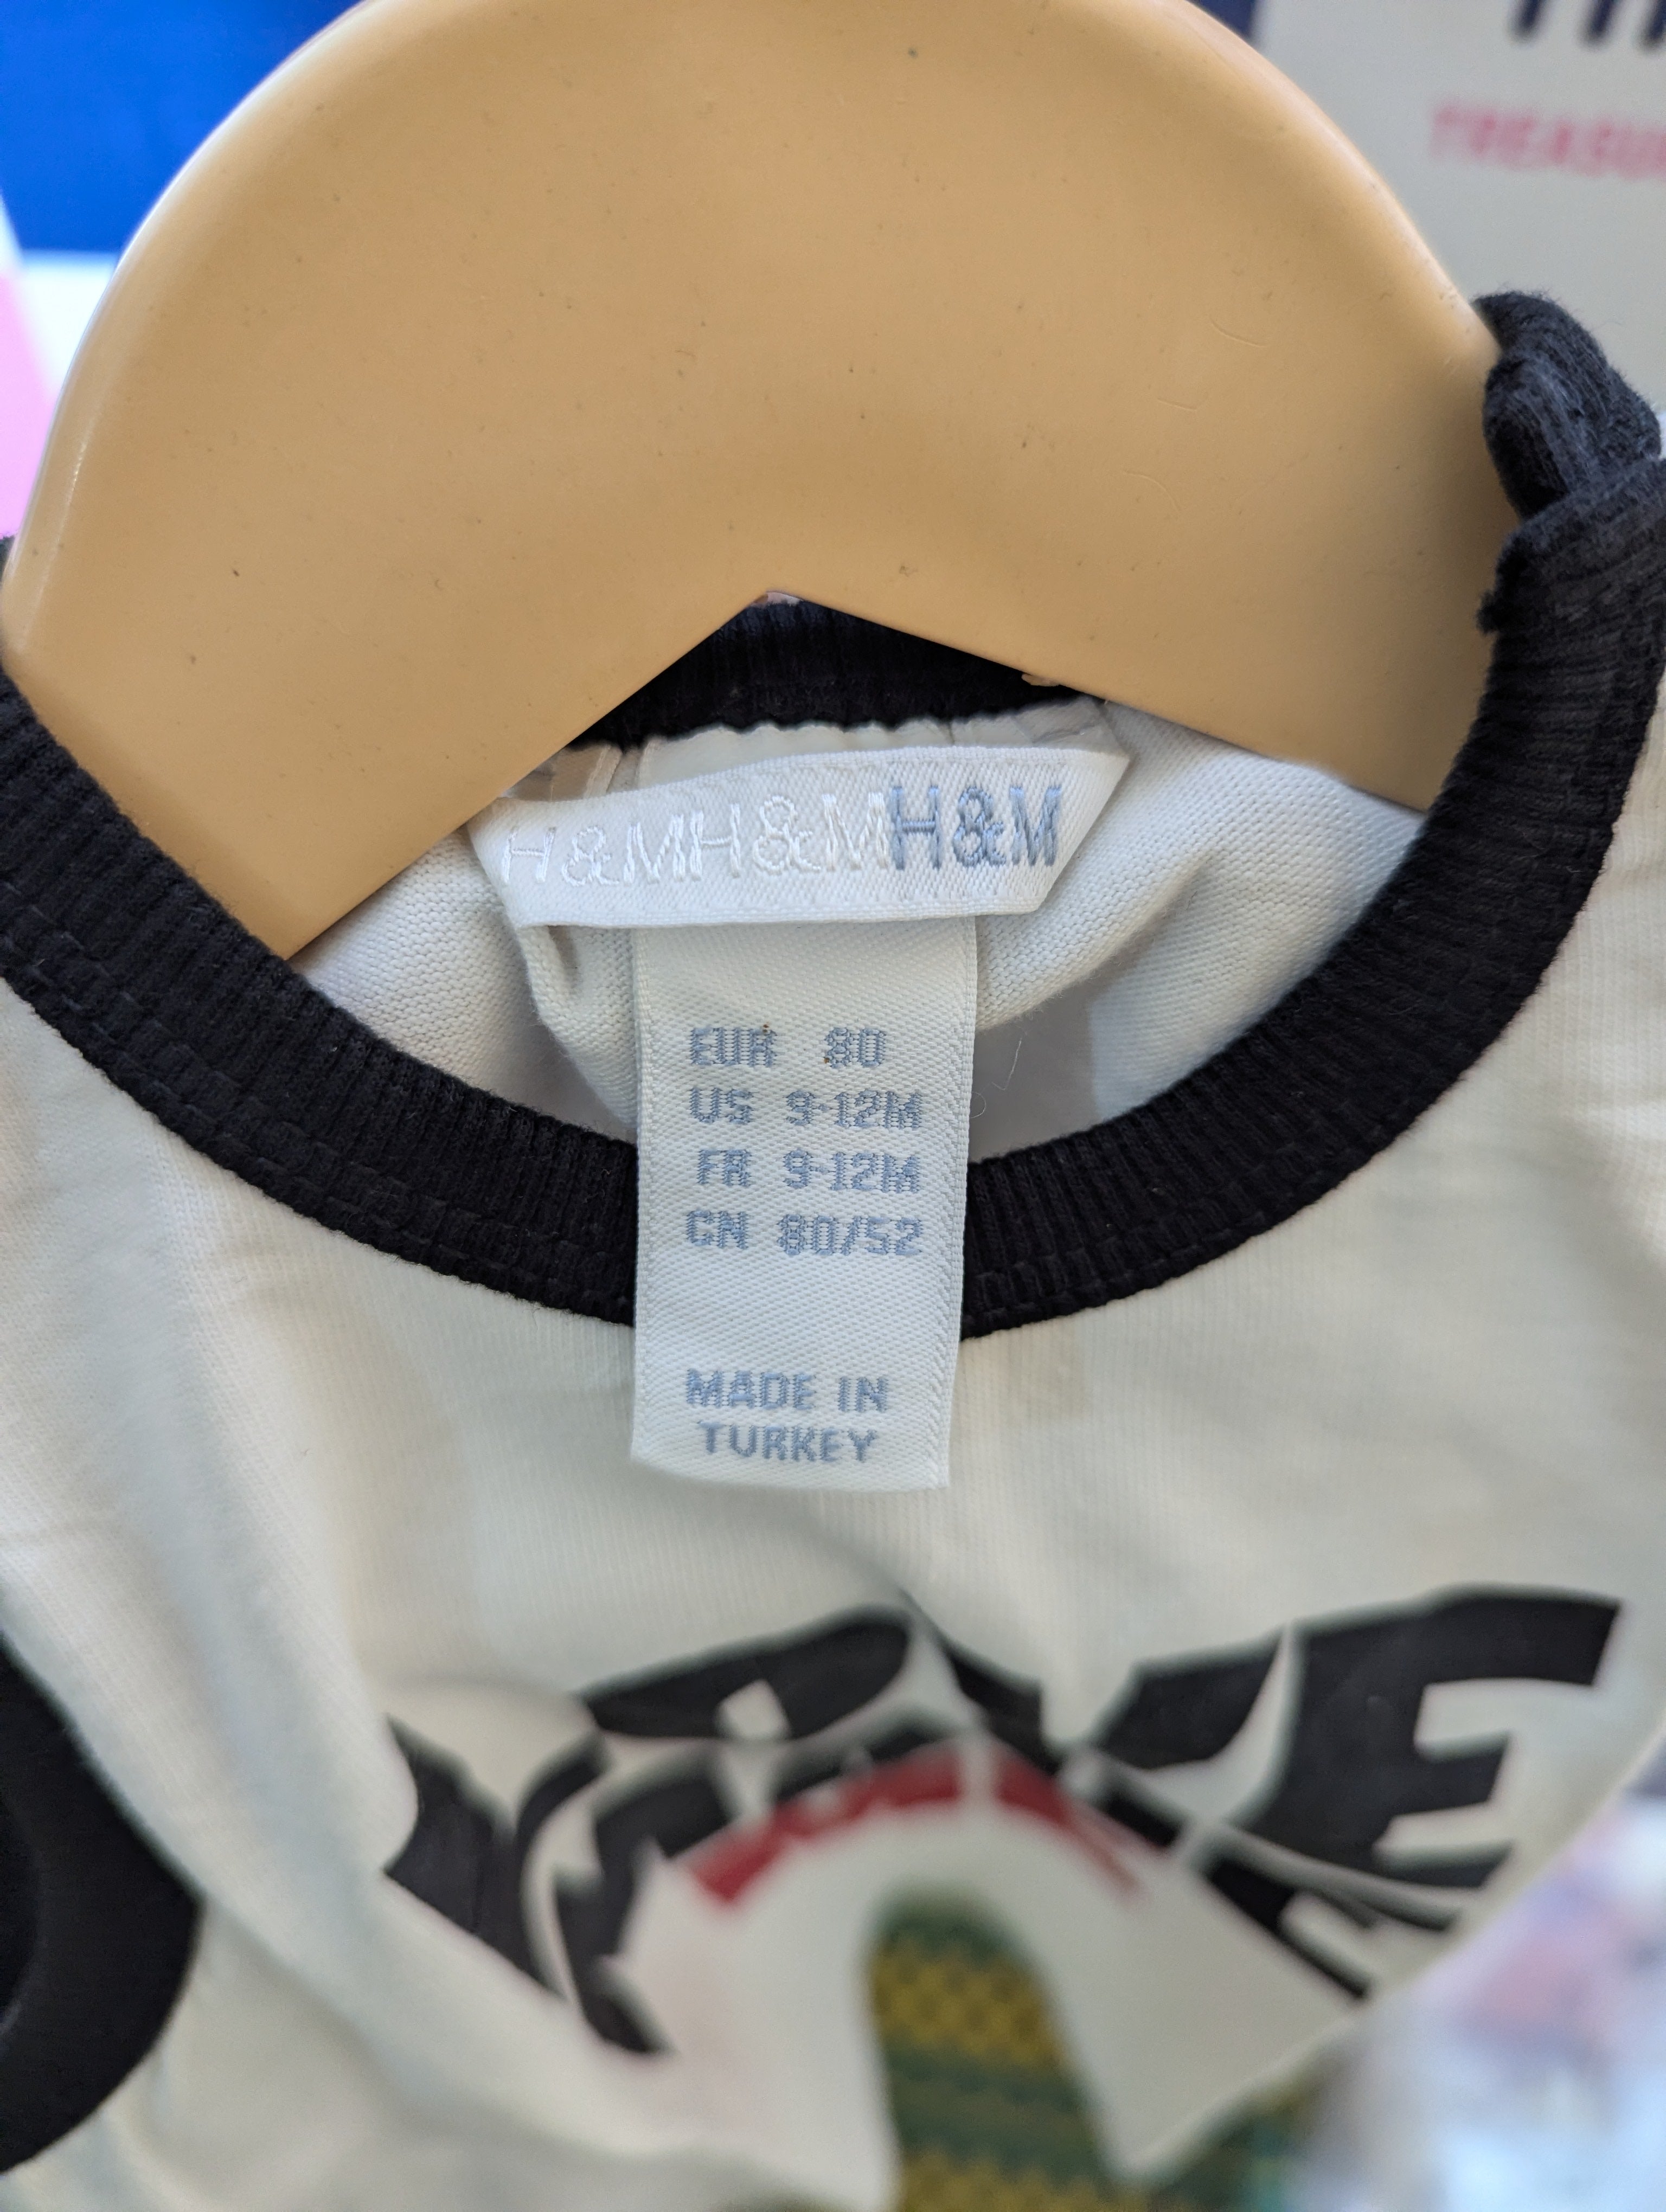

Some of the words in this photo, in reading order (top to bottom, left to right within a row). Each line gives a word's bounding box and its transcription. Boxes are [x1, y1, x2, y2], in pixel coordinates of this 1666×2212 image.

[889, 785, 1062, 870] H&M
[690, 1027, 777, 1068] EUR
[824, 1026, 886, 1068] 80
[689, 1086, 754, 1125] US
[785, 1090, 922, 1130] 9-12M
[696, 1148, 753, 1187] FR
[783, 1148, 921, 1193] 9-12M
[686, 1210, 751, 1249] CN
[776, 1213, 922, 1256] 80/52
[685, 1368, 816, 1409] MADE
[837, 1376, 888, 1412] IN
[697, 1418, 877, 1463] TURKEY
